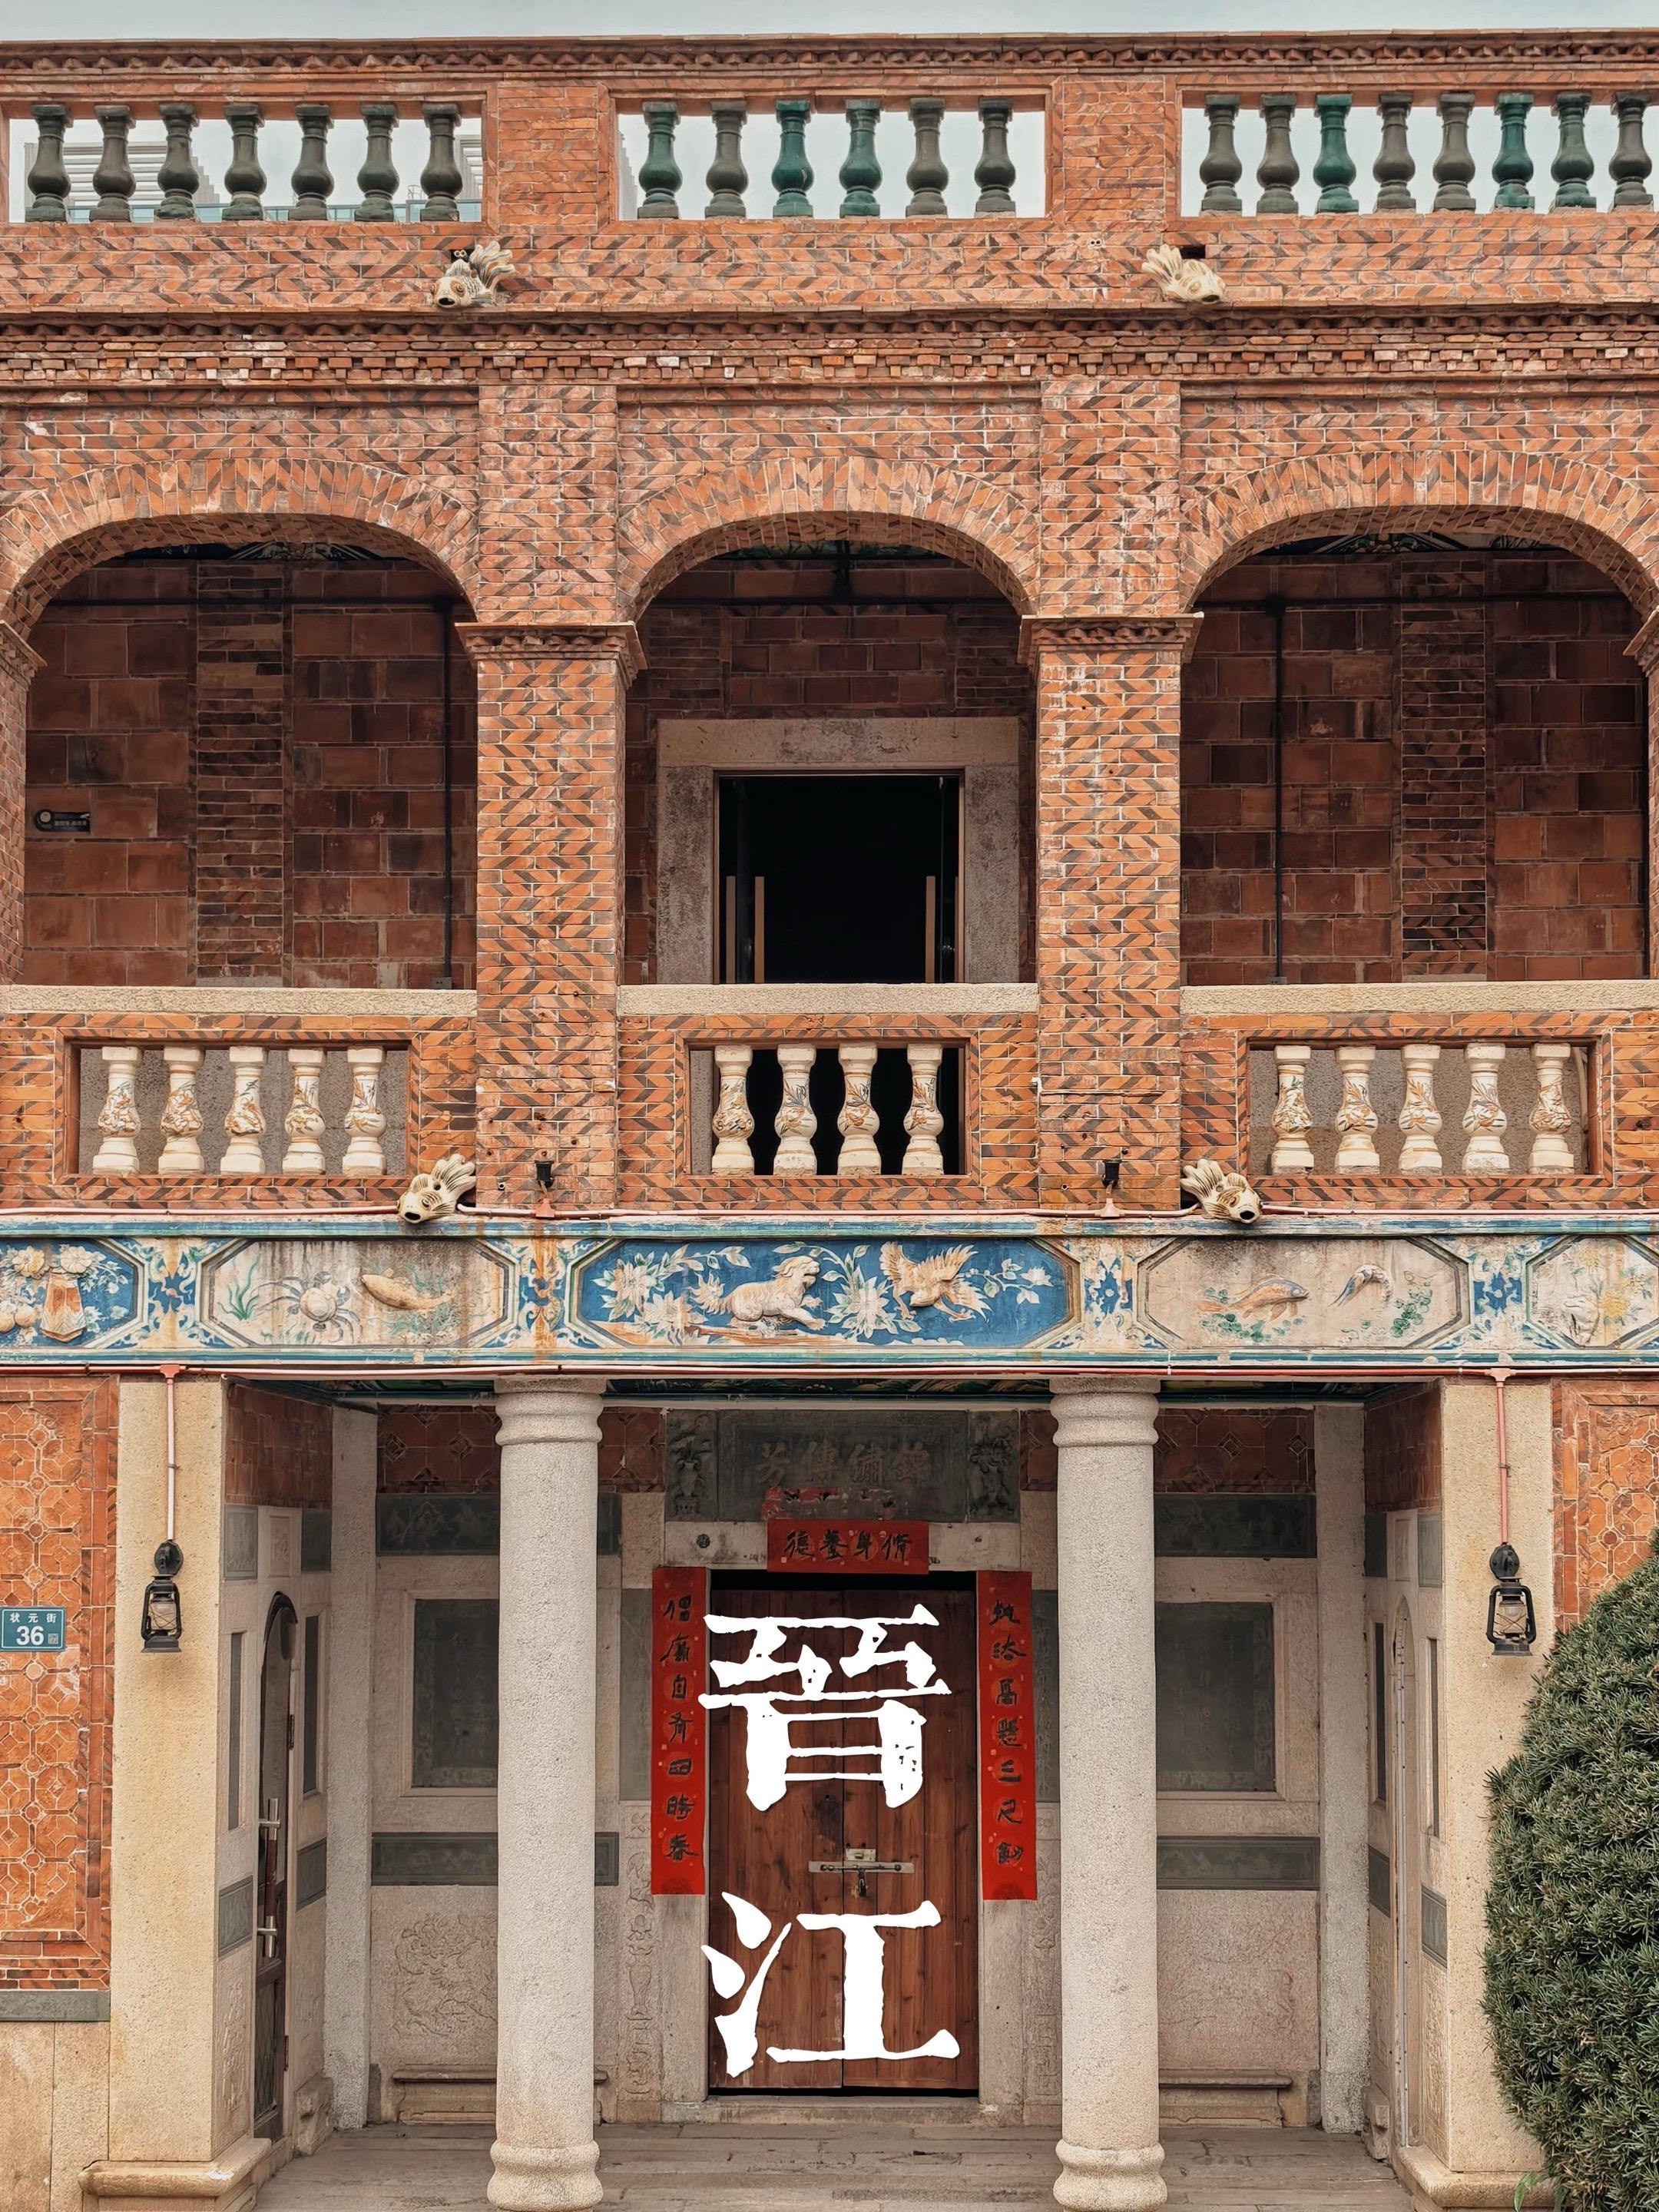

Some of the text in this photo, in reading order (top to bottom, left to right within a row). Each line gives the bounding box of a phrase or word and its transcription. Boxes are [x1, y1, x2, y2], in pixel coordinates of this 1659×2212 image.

[9, 1612, 57, 1624] 状元街
[16, 1625, 45, 1646] 36
